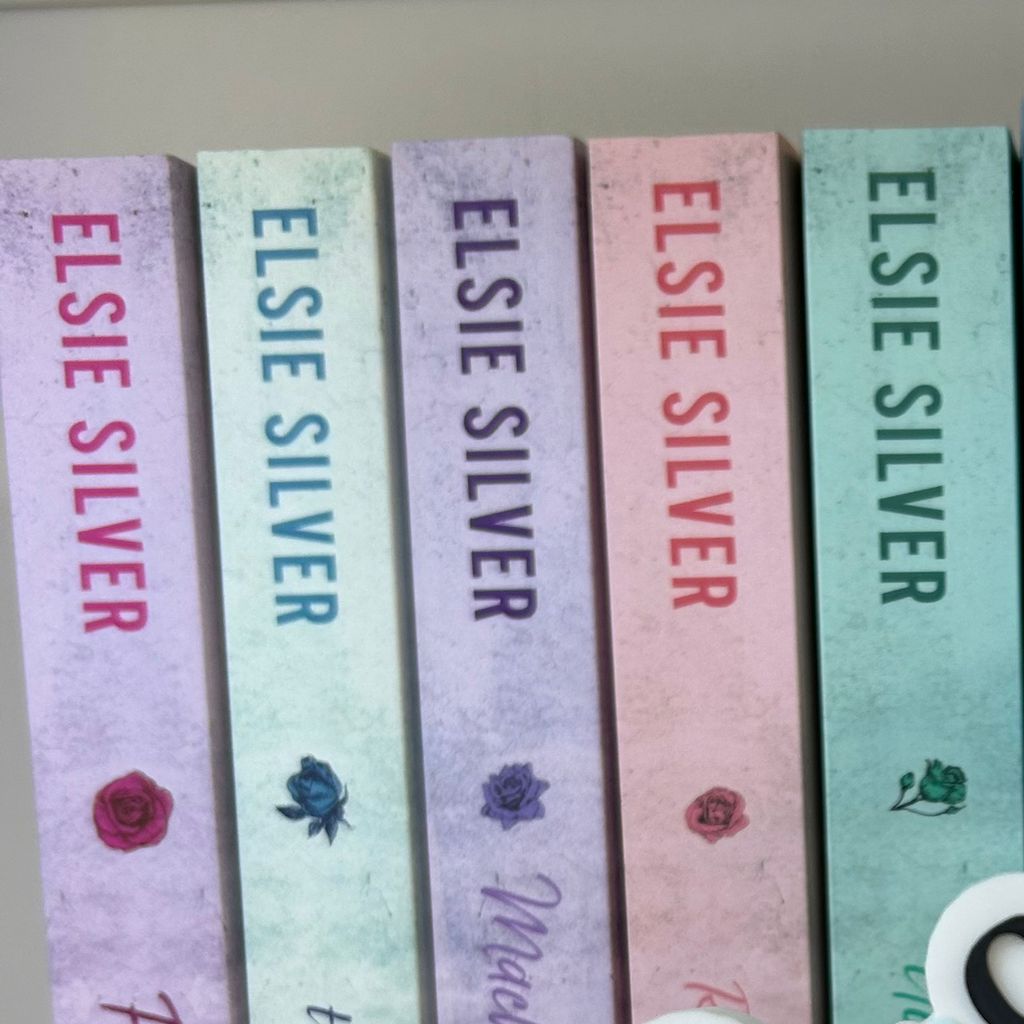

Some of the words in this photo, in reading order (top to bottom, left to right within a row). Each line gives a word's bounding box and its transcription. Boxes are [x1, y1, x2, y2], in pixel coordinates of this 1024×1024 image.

[51, 214, 131, 389] ELSIE
[252, 207, 326, 383] ELSIE
[452, 199, 525, 375] ELSIE
[652, 180, 727, 360] ELSIE
[868, 171, 939, 352] ELSIE
[67, 420, 148, 634] SILVER
[264, 413, 339, 626] SILVER
[462, 406, 538, 622] SILVER
[661, 392, 738, 610] SILVER
[872, 384, 947, 606] SILVER
